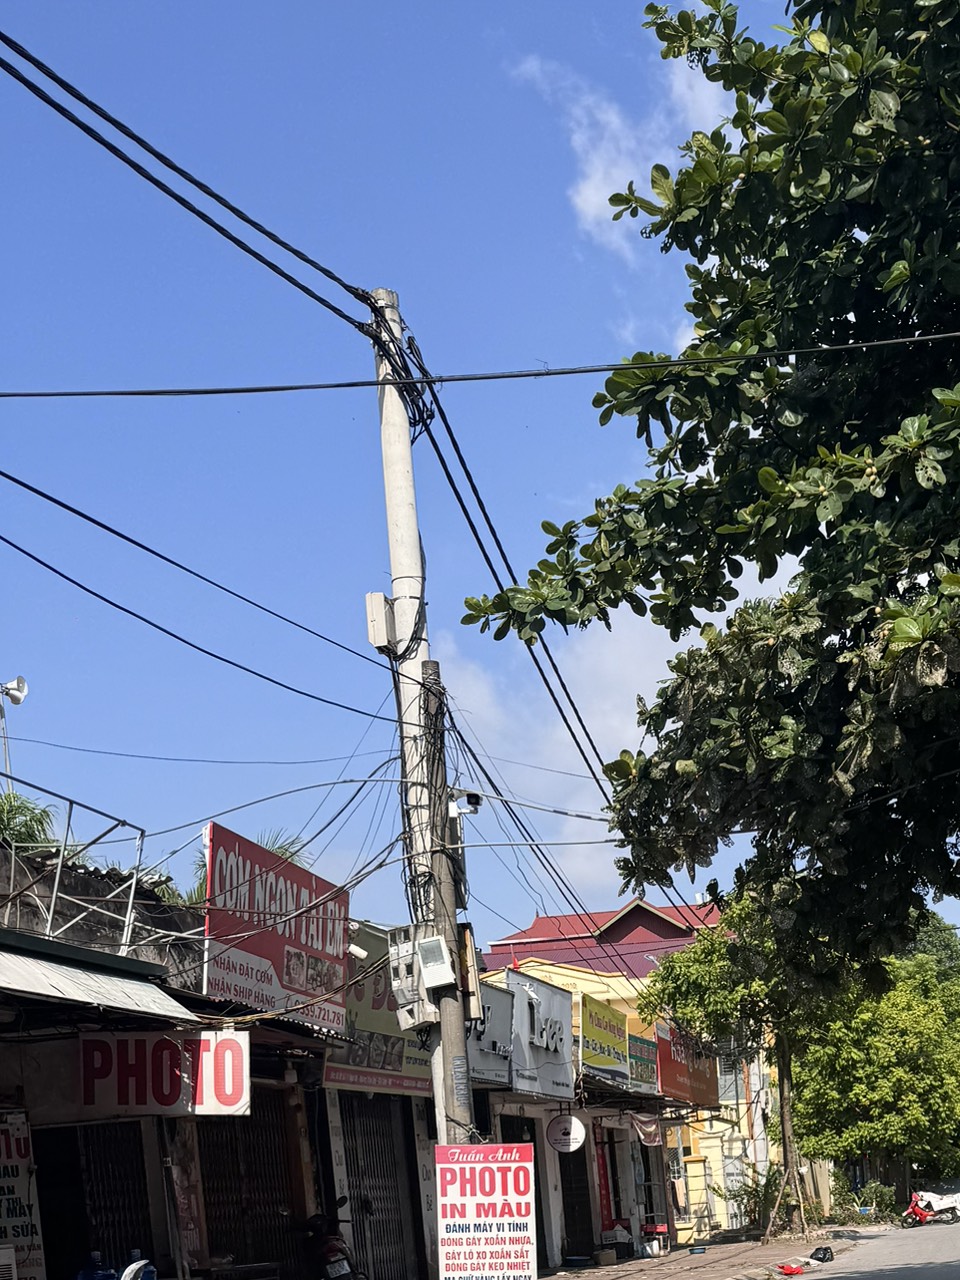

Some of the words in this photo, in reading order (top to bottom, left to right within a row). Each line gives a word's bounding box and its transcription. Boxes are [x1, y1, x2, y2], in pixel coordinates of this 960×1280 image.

[214, 842, 251, 921] CƠM
[254, 864, 297, 939] NGON
[212, 954, 238, 975] NHẬN
[238, 963, 254, 980] ĐẶT
[255, 968, 273, 986] CƠM
[207, 977, 232, 997] NHẬN
[233, 983, 253, 1000] SHIP
[254, 987, 276, 1009] HÀNG
[82, 1038, 244, 1106] PHOTO
[448, 1148, 484, 1163] Tuấn
[488, 1147, 520, 1161] Anh
[440, 1165, 530, 1198] PHOTO
[441, 1203, 466, 1219] IN
[475, 1199, 531, 1219] MÀU
[445, 1221, 471, 1233] ĐÁNH
[473, 1221, 493, 1233] MÁY
[496, 1222, 505, 1233] VI
[507, 1220, 528, 1232] TÍNH
[484, 1234, 506, 1246] XOẮN
[476, 1251, 487, 1260] XO
[489, 1247, 511, 1260] XOẮN
[513, 1246, 529, 1259] SẮT
[507, 1260, 531, 1272] NHIỆT
